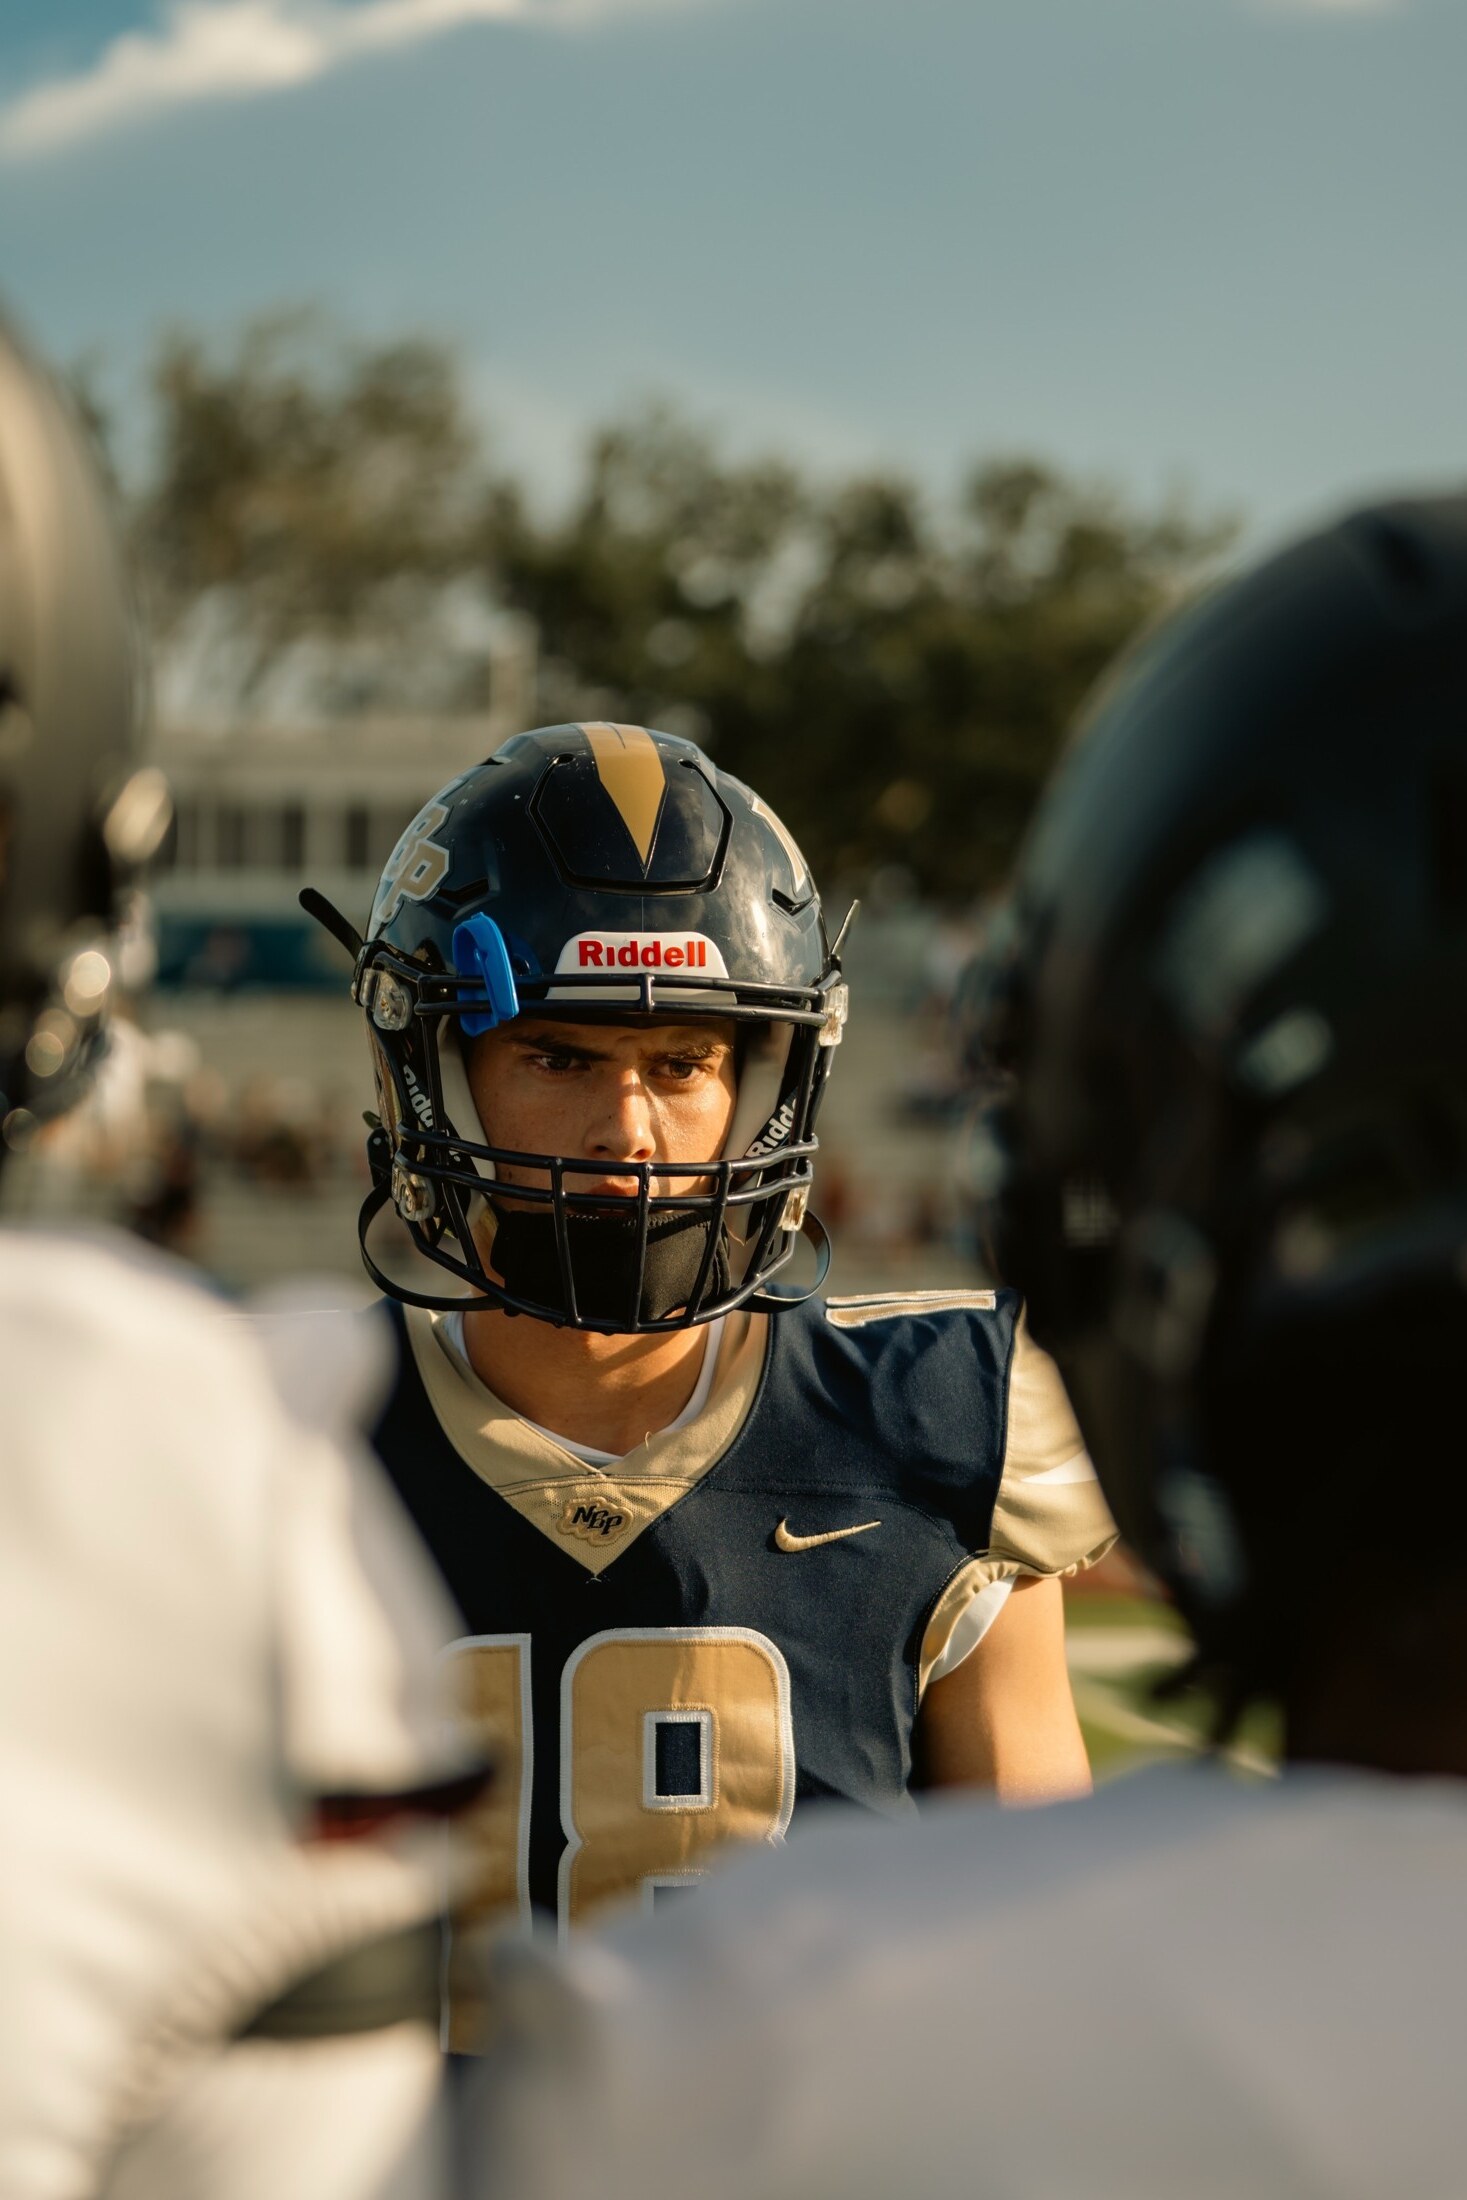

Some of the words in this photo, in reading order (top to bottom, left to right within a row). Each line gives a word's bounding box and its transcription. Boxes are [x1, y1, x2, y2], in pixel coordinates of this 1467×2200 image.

[578, 940, 706, 968] Riddell
[744, 1098, 796, 1158] Ridd
[572, 1505, 623, 1535] NBP
